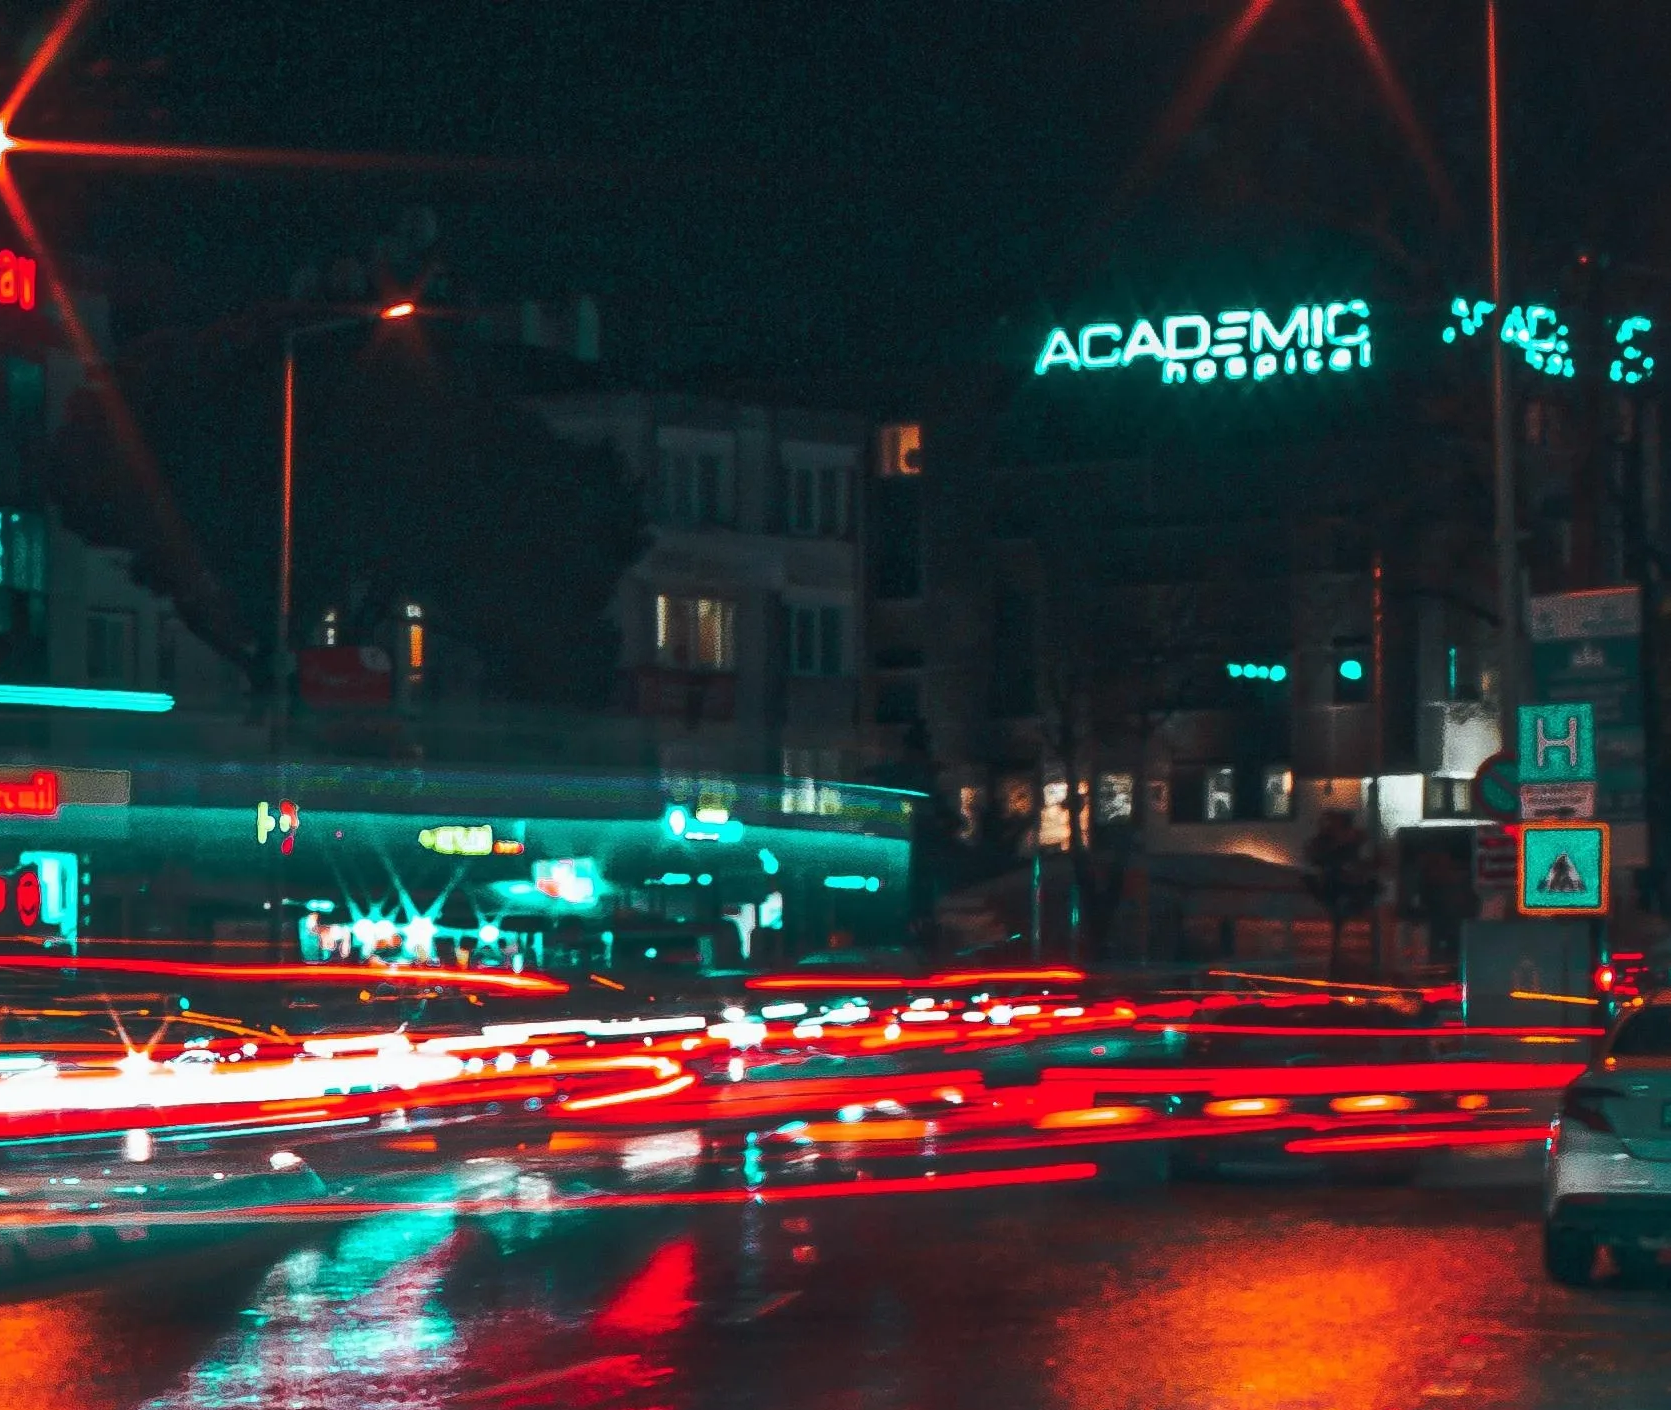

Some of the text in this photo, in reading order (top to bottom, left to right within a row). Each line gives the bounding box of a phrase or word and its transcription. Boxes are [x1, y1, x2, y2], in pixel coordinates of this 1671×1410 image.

[1033, 299, 1370, 376] ACADEMIC
[1162, 341, 1371, 384] hospital
[1536, 715, 1578, 768] H
